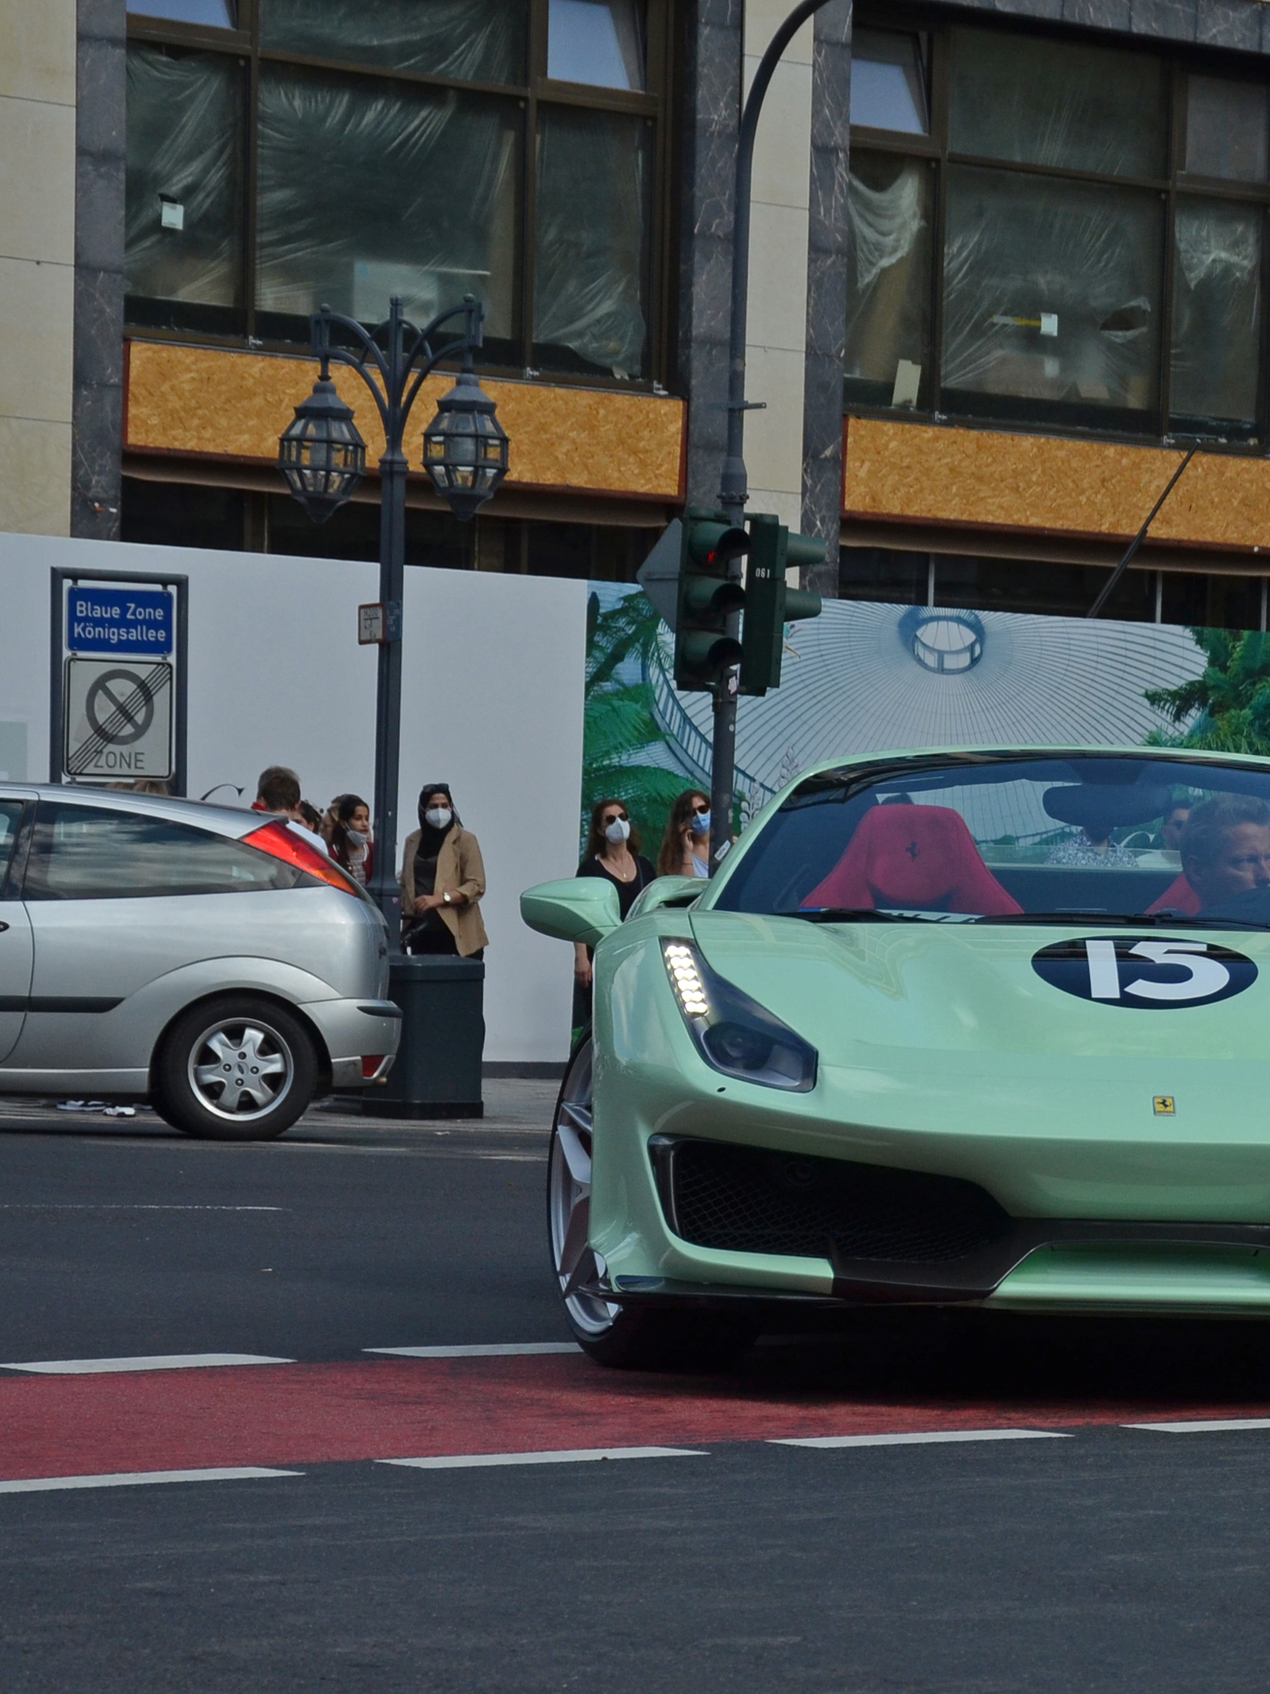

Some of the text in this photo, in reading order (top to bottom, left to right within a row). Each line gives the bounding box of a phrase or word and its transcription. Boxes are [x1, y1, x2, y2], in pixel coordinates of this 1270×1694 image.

[755, 567, 770, 579] 061
[76, 601, 164, 620] Blaue Zone
[74, 622, 166, 643] Königsallee
[93, 750, 146, 770] ZONE
[1085, 939, 1230, 1000] 15
